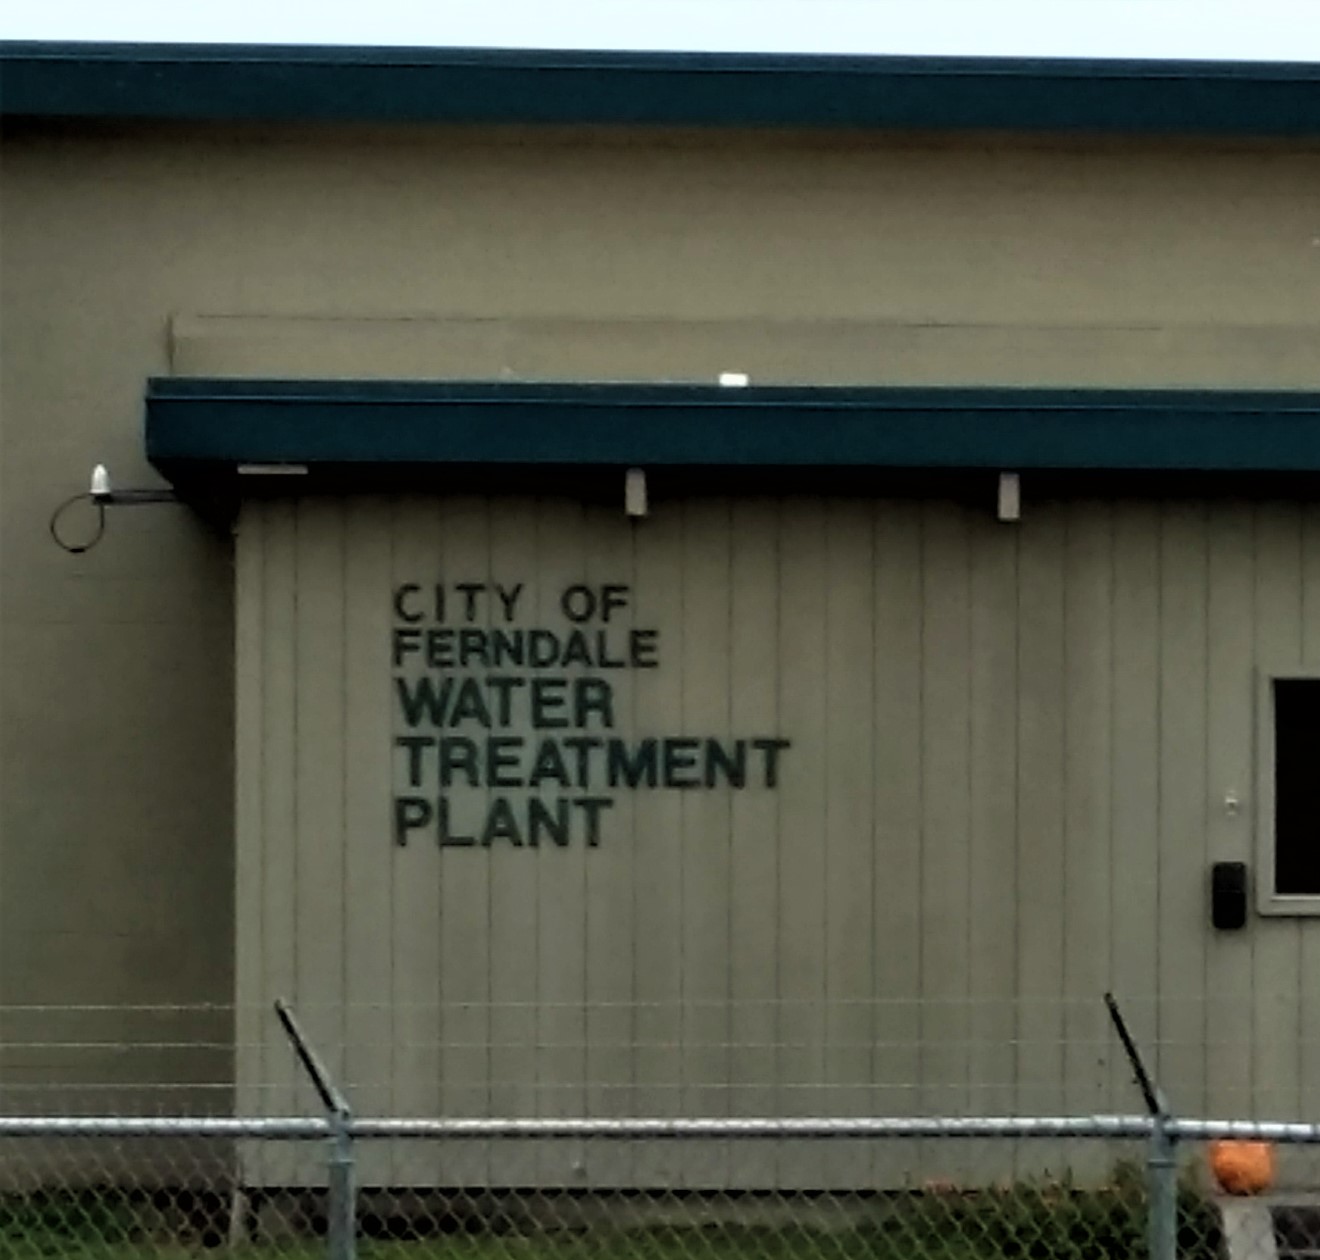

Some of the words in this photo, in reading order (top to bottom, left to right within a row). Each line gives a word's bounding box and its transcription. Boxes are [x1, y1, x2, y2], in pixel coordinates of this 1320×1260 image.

[394, 583, 523, 624] CITY
[560, 584, 630, 623] OF
[393, 628, 660, 669] FERNDALE
[395, 676, 614, 728] WATER
[396, 736, 791, 789] TREATMENT
[396, 797, 614, 848] PLANT
